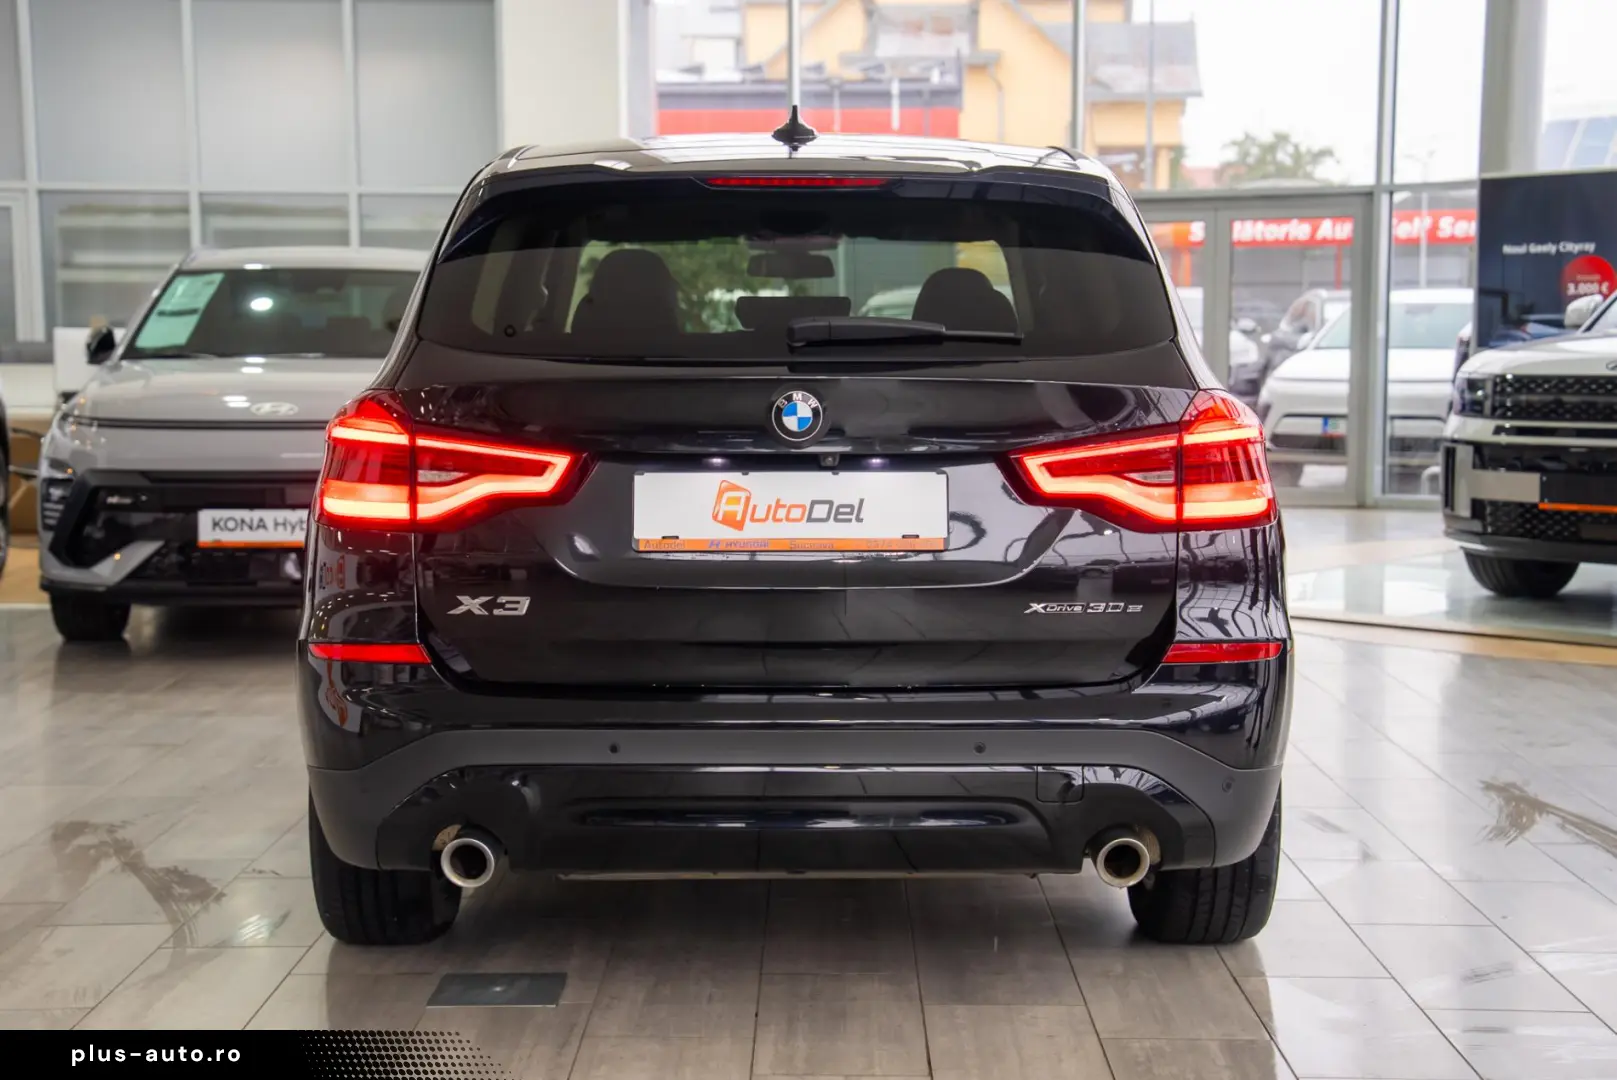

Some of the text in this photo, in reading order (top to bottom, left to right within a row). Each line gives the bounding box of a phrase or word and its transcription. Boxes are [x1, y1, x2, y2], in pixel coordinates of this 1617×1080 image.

[777, 392, 818, 409] BMW
[714, 488, 864, 524] AutoDel
[212, 516, 268, 532] KONA
[446, 595, 531, 616] X3
